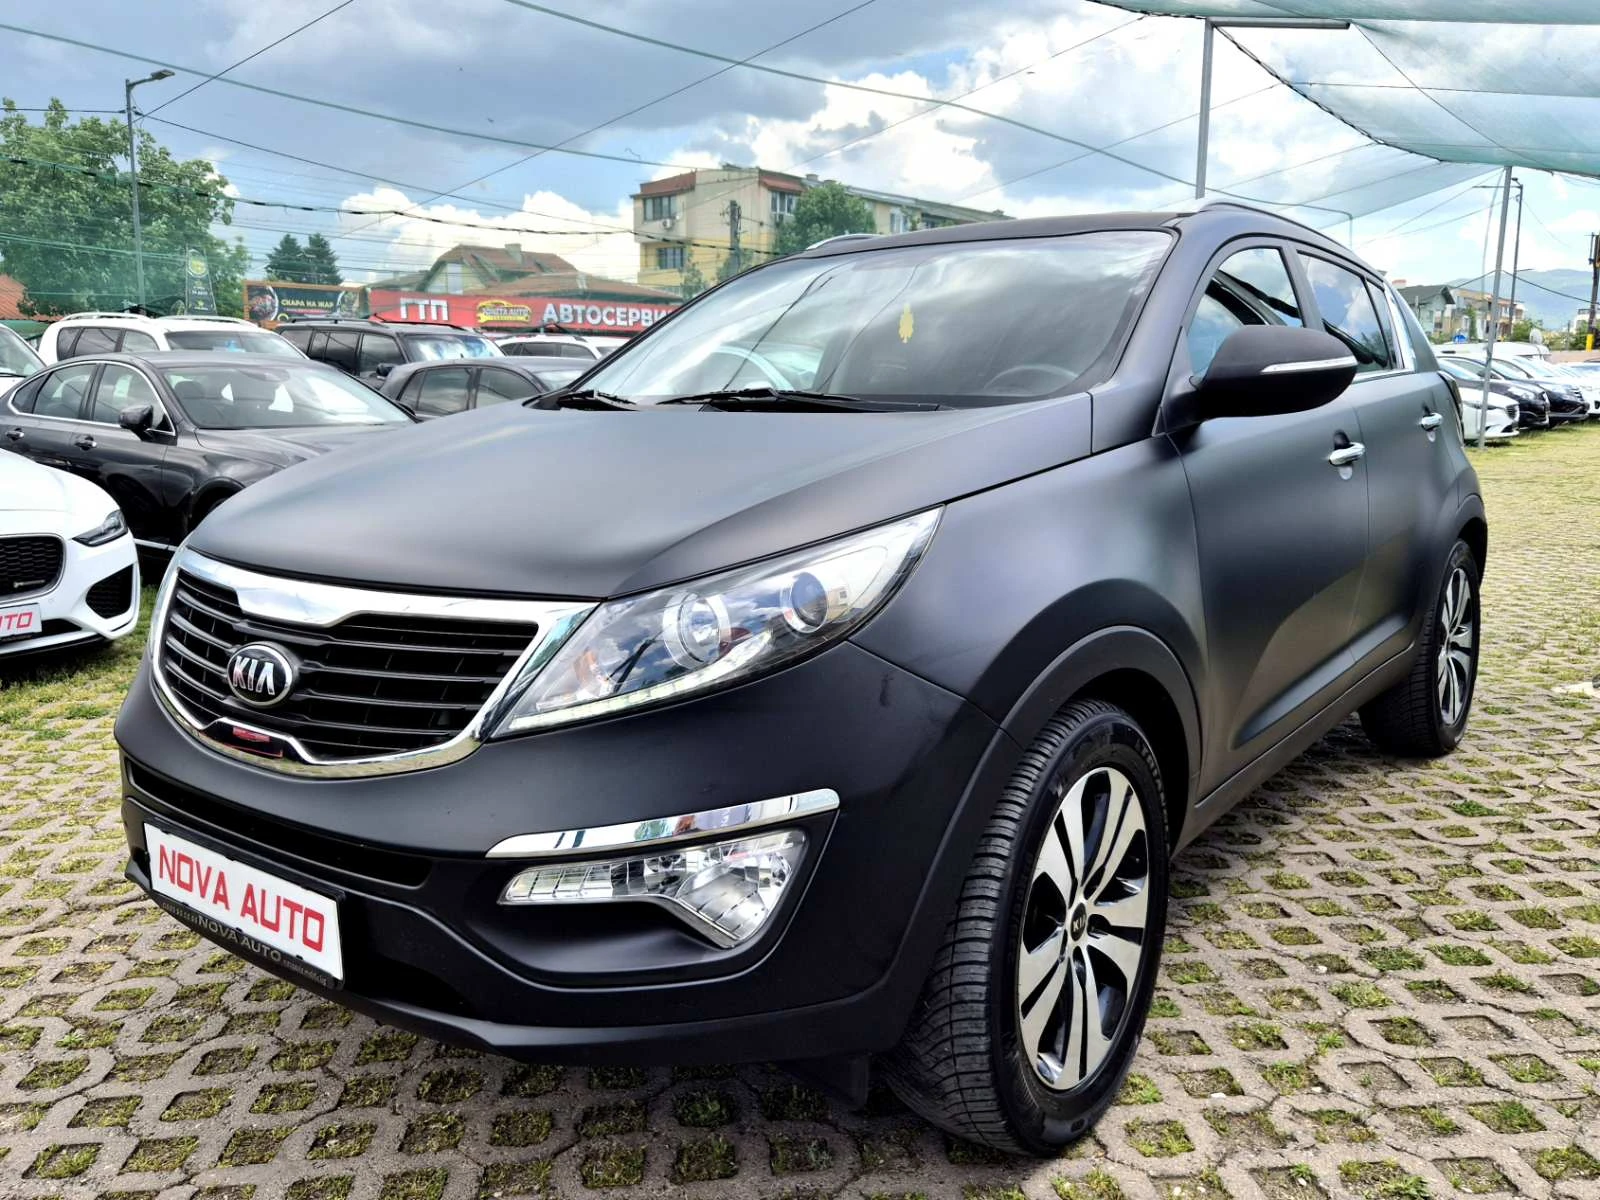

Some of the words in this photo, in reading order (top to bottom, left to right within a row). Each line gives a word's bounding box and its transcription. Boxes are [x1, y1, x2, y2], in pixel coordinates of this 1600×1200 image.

[400, 297, 448, 321] ГТП
[542, 302, 673, 328] АВТОСЕРВИ
[0, 612, 33, 631] TO
[232, 655, 276, 696] KIA
[159, 844, 231, 911] NOVA
[240, 883, 325, 953] AUTO
[198, 914, 239, 943] NOVA
[241, 937, 282, 962] AUTO
